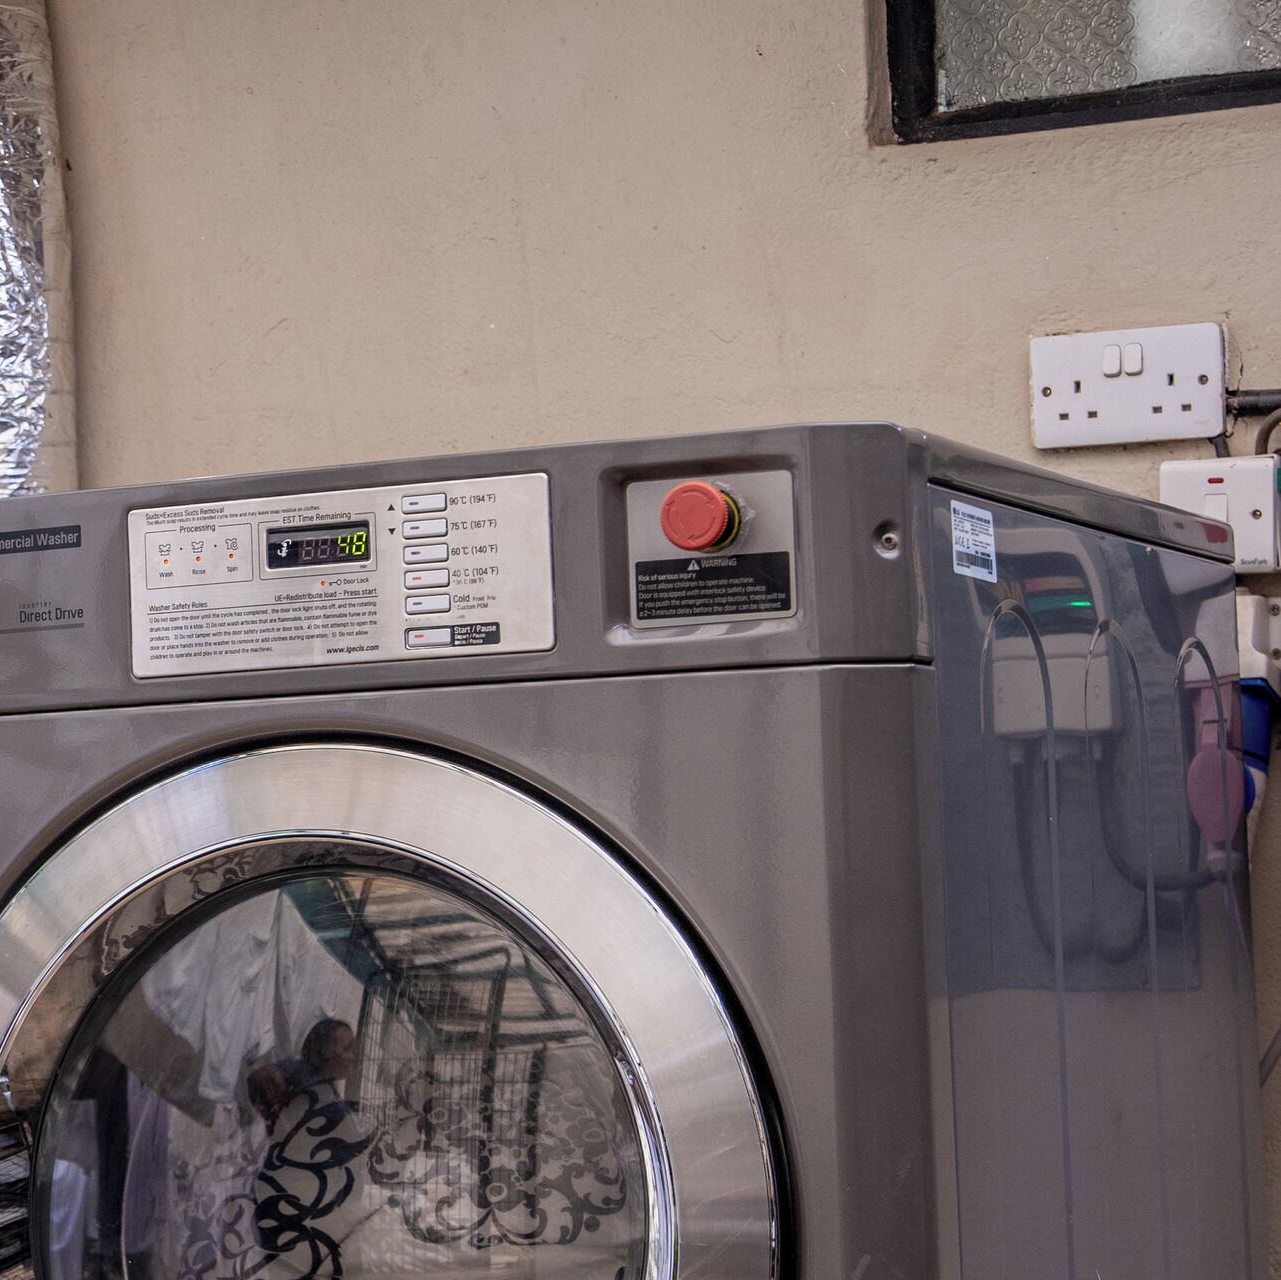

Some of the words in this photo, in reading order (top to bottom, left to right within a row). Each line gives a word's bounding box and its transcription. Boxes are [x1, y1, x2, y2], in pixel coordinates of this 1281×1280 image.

[449, 497, 458, 505] 90
[185, 509, 199, 517] Suds
[200, 507, 225, 515] Removal
[315, 511, 351, 523] Remaining
[179, 523, 216, 535] Processing
[450, 522, 459, 531] 75
[36, 531, 79, 546] Washer
[451, 547, 461, 556] 60
[701, 558, 737, 568] WARNING
[227, 565, 238, 573] Spin
[452, 569, 461, 578] 40
[679, 572, 697, 580] injury
[344, 589, 360, 597] Press
[453, 594, 470, 603] Cold
[149, 604, 170, 612] Washer
[172, 603, 191, 611] Safety
[192, 601, 208, 609] Rules
[19, 609, 52, 623] Direct
[55, 606, 85, 620] Drive
[454, 626, 471, 634] Start
[477, 624, 497, 632] Pause
